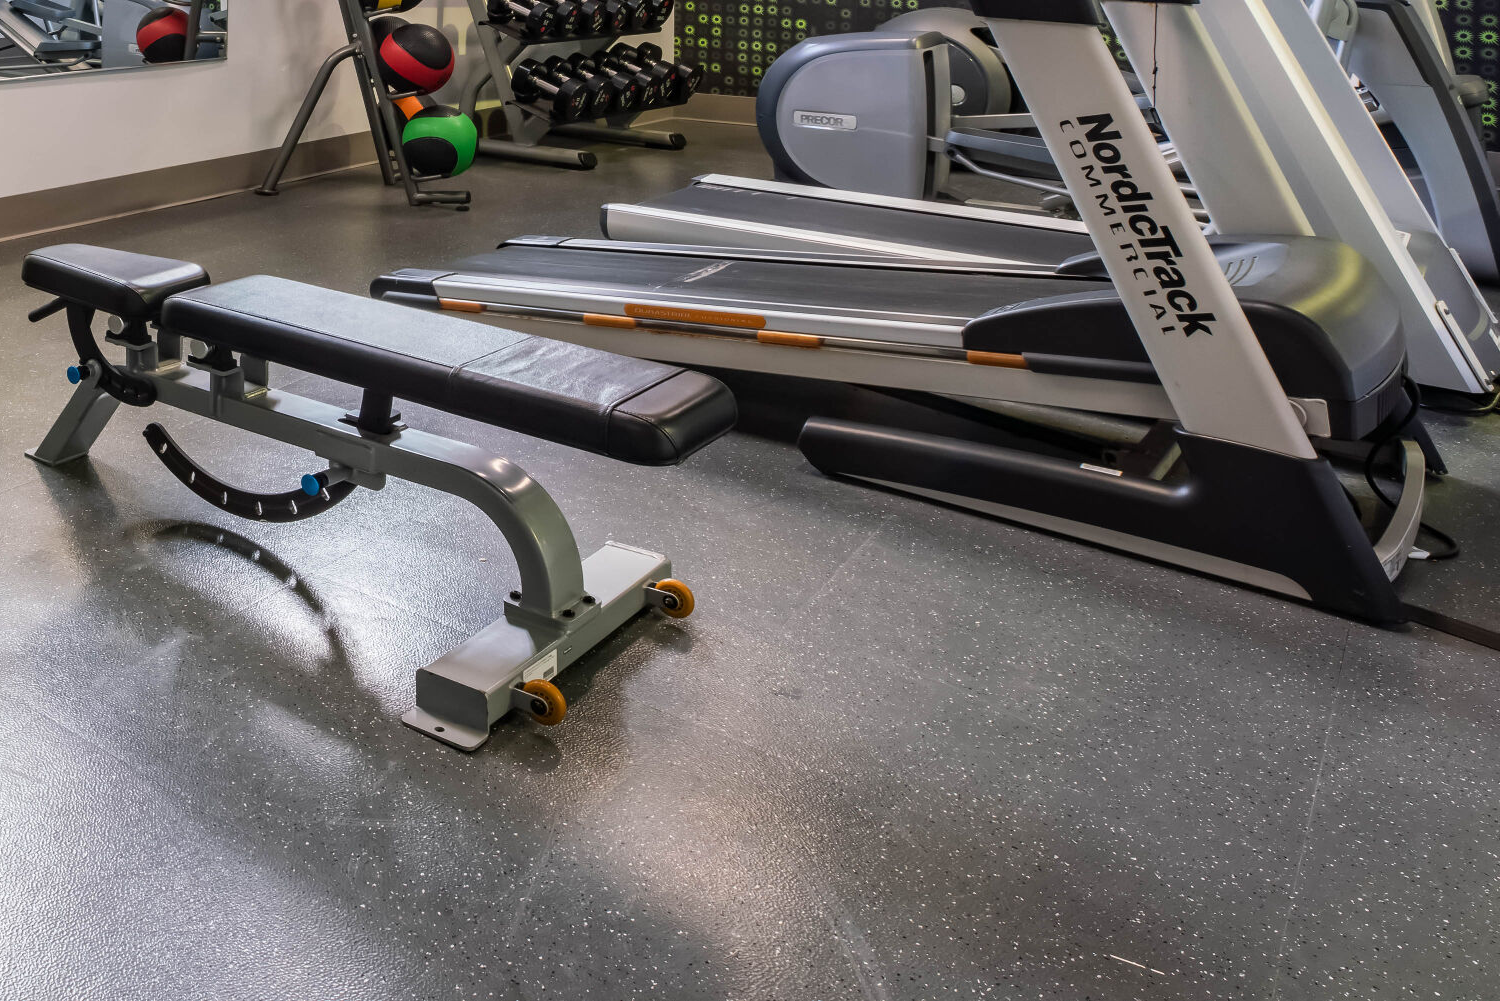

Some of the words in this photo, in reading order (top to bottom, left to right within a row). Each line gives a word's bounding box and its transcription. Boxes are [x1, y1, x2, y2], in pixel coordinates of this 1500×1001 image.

[799, 113, 845, 127] PRECOR
[1059, 119, 1177, 336] COMMERCIAL
[1076, 112, 1218, 338] NordicTrack
